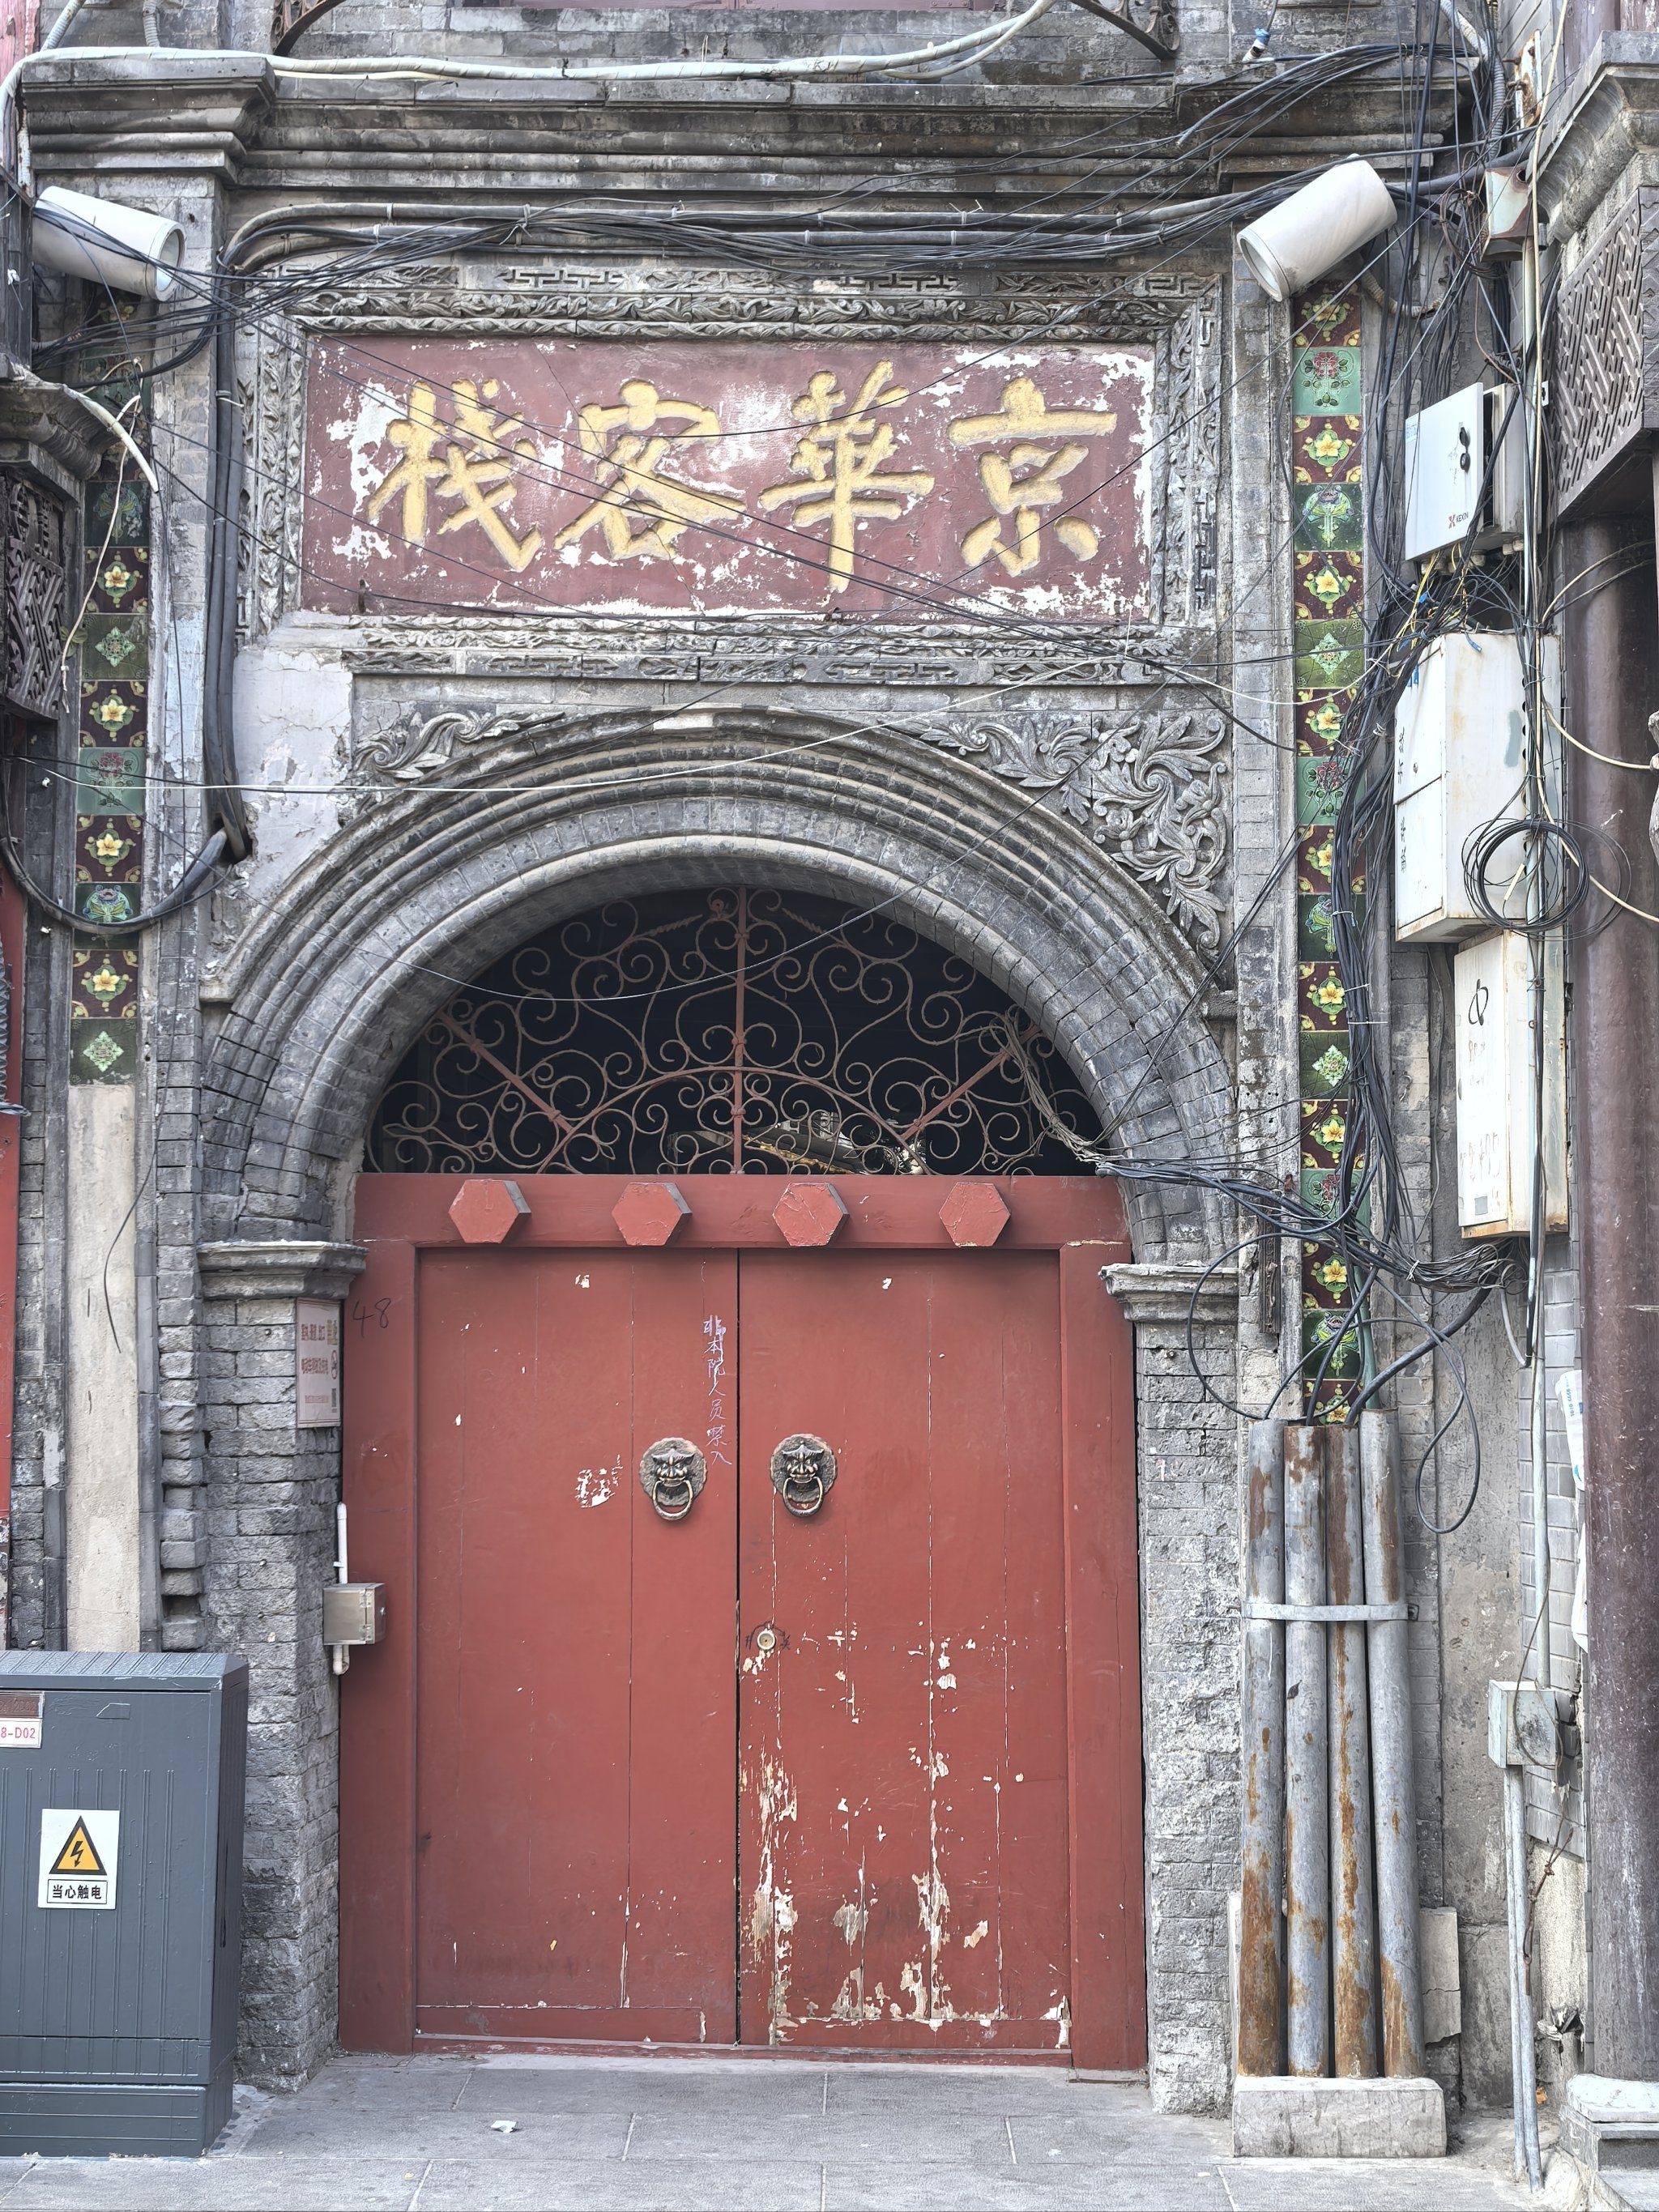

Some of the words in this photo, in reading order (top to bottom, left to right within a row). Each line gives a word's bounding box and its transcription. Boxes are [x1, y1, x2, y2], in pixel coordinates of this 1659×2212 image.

[352, 1298, 392, 1338] 48
[702, 1315, 733, 1465] 非本院人员禁入
[1, 1727, 36, 1739] 8-D02
[52, 1884, 102, 1900] 当心触电
